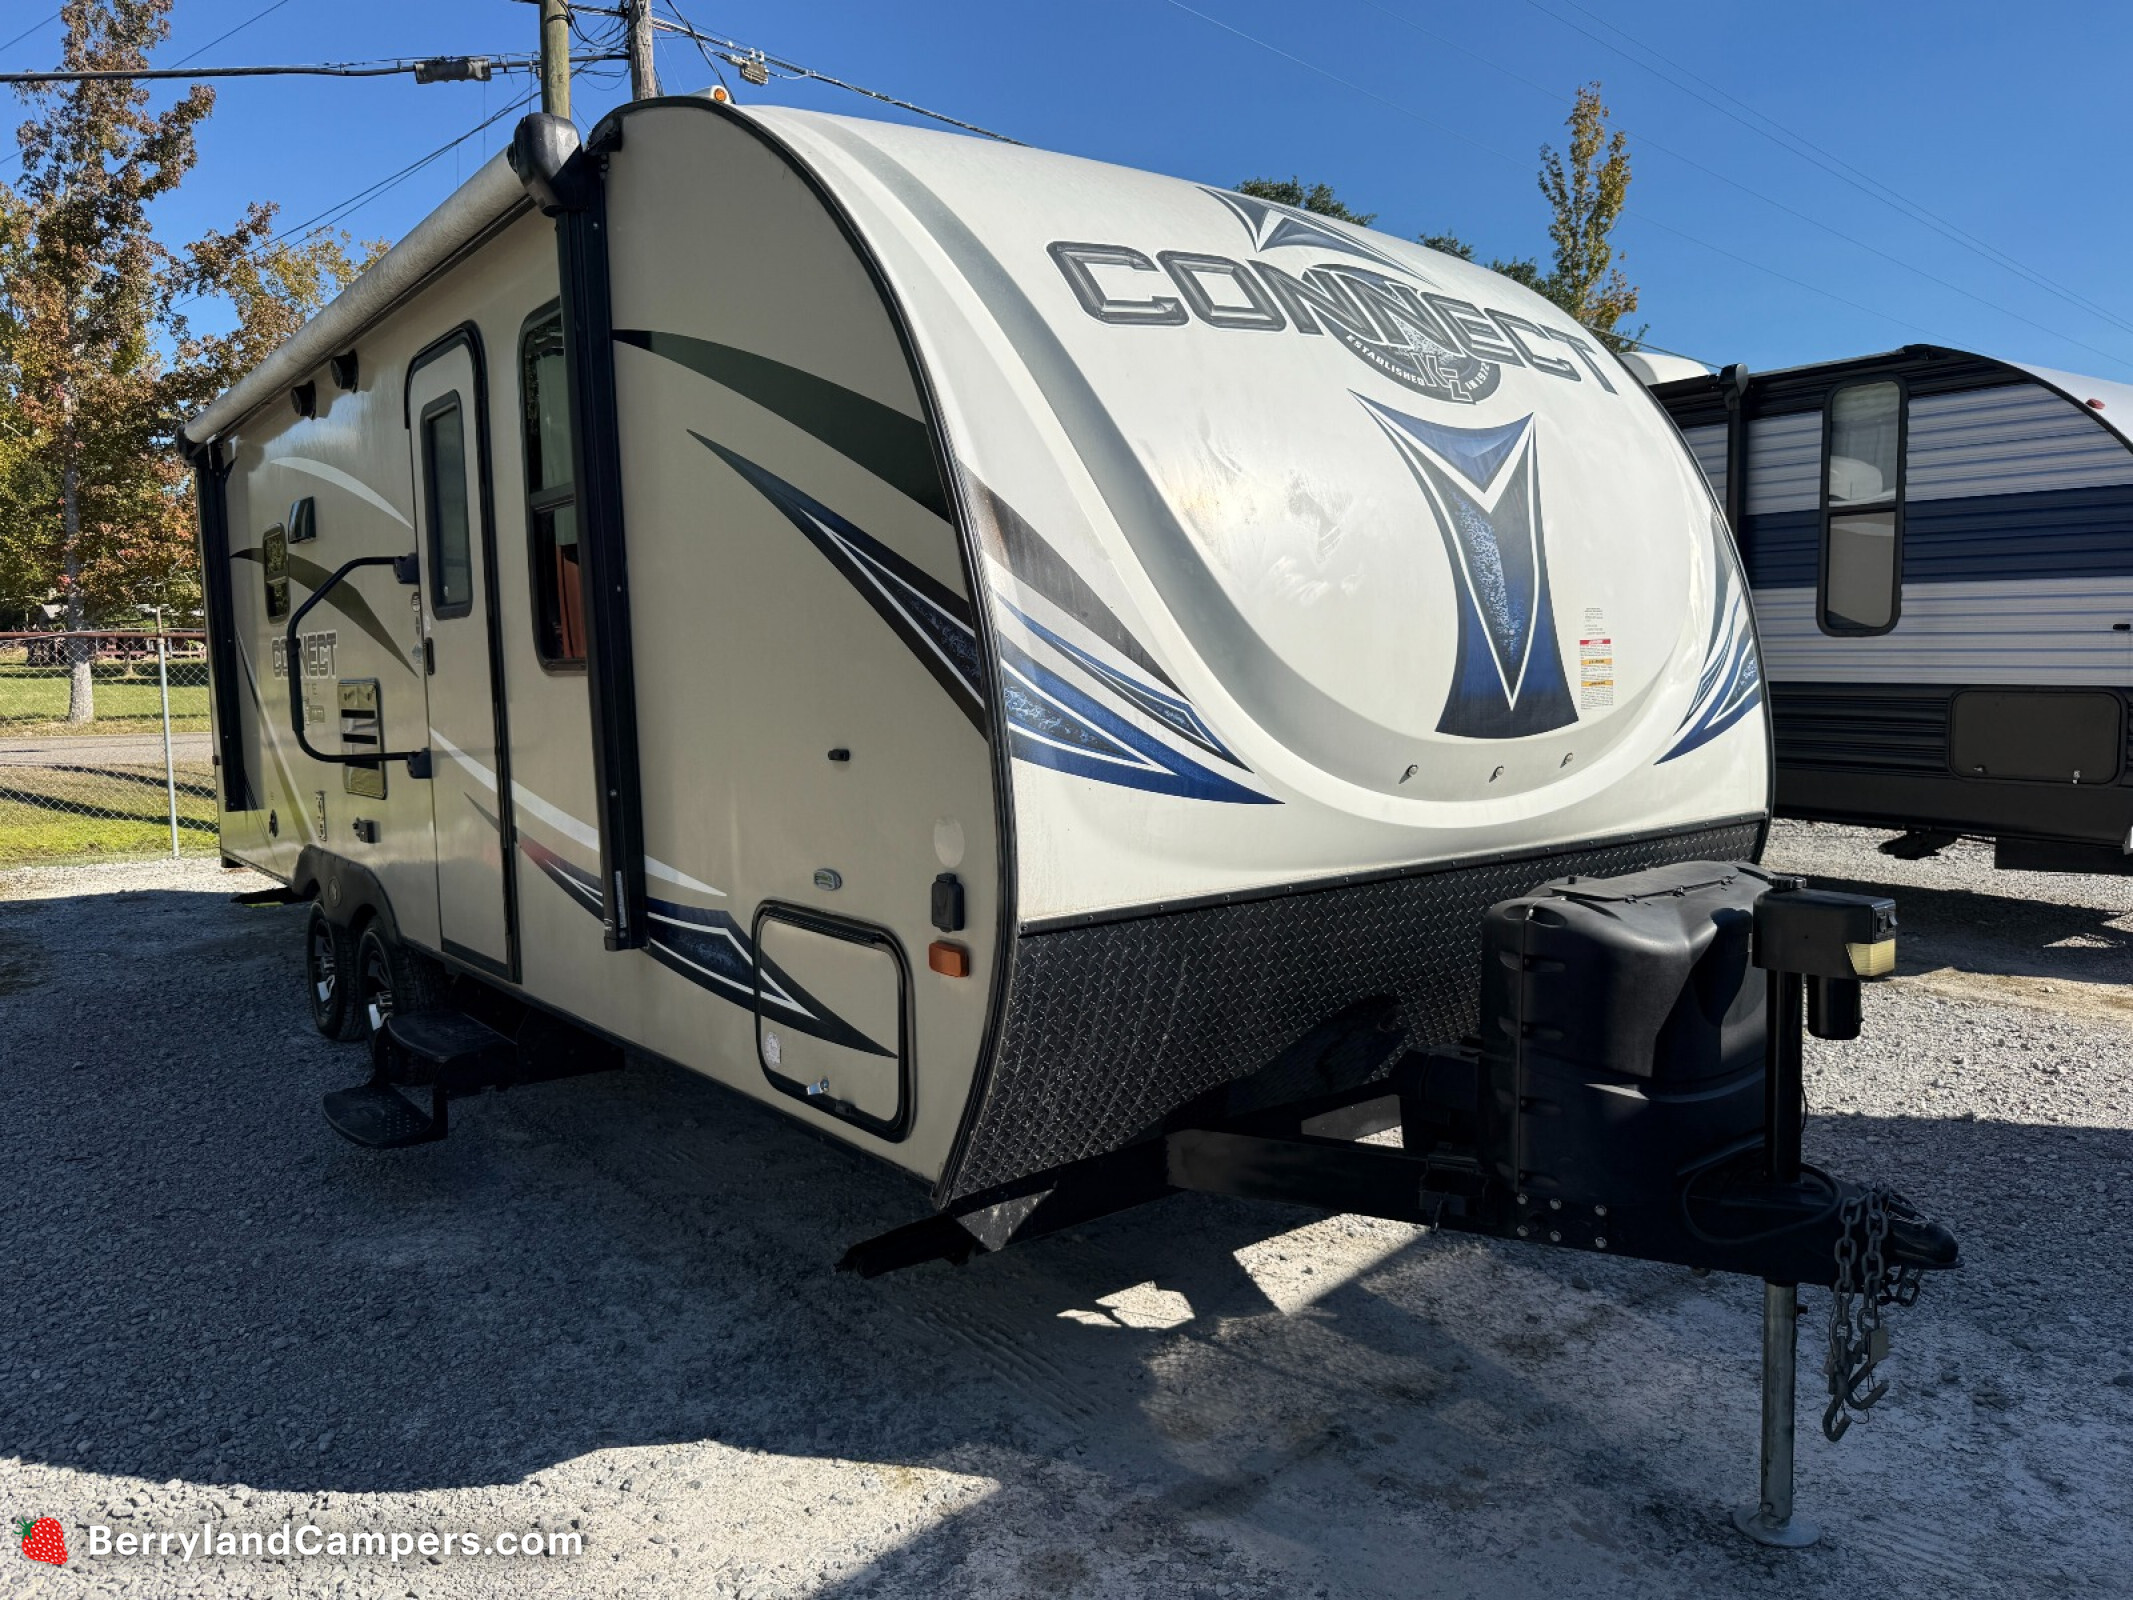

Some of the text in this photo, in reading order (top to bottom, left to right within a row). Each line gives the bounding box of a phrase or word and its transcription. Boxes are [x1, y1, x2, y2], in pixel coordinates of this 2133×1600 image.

[1046, 240, 1618, 396] CONNECT
[1346, 334, 1490, 391] ESTABLISHED IN 1972
[272, 629, 337, 680] CONECT
